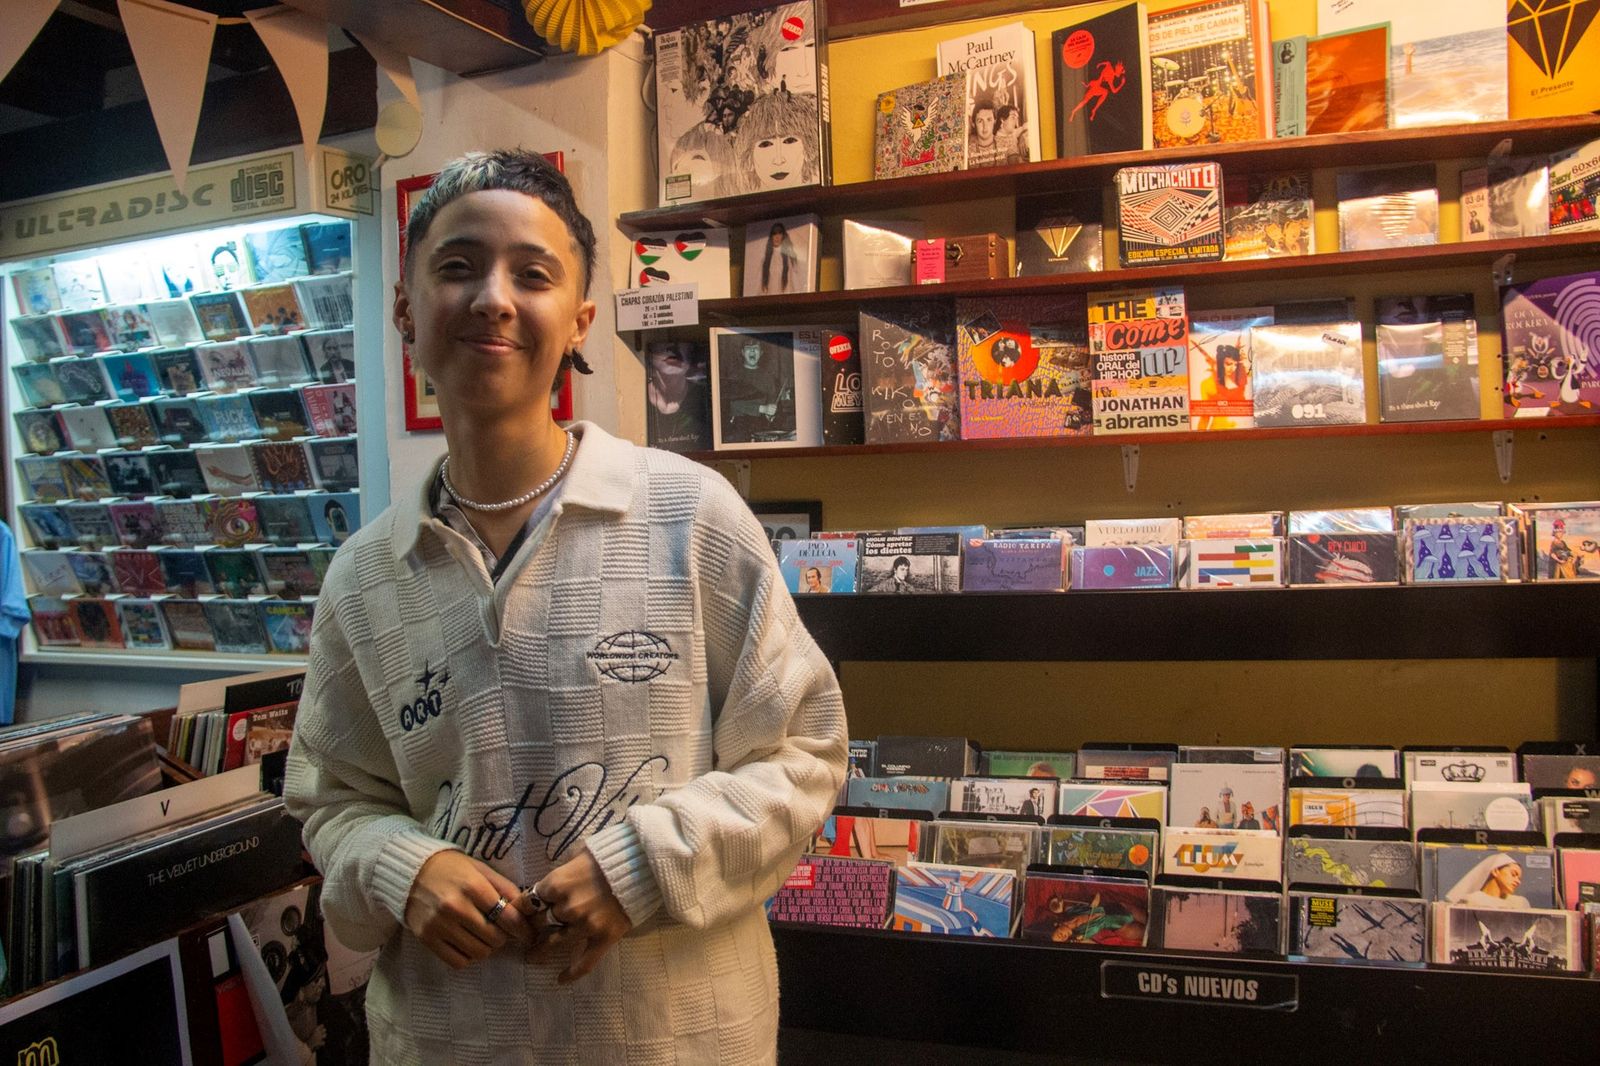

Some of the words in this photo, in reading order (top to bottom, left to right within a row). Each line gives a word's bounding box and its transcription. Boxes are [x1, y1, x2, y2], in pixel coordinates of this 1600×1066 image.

[967, 36, 994, 55] Paul
[948, 50, 1016, 74] McCartney
[820, 63, 831, 124] REVOLVER
[1540, 80, 1575, 94] Presente
[245, 161, 283, 175] COMPACT
[331, 163, 366, 190] ORO
[1121, 164, 1216, 195] MUCHACHITO
[230, 168, 284, 203] disc
[232, 201, 260, 212] DIGITAL
[261, 196, 285, 208] AUDIO
[330, 193, 340, 204] 24
[1155, 248, 1187, 257] ESPECIAL
[1188, 245, 1219, 255] LIMITADA
[621, 295, 641, 307] CHAPAS
[666, 291, 694, 302] PALESTINO
[1097, 298, 1148, 321] THE
[829, 343, 852, 355] OFERTA
[1099, 351, 1136, 361] historia
[1096, 361, 1125, 371] ORAL
[1125, 360, 1140, 370] del
[1100, 370, 1117, 380] HIP
[1117, 369, 1140, 380] HOP
[964, 378, 1063, 401] TRIANA
[1100, 396, 1184, 412] JONATHAN
[1291, 403, 1326, 419] 091
[1105, 413, 1179, 430] abrams
[880, 546, 913, 554] dientes
[1327, 541, 1342, 553] REY
[1343, 540, 1367, 553] CHICO
[1134, 566, 1159, 577] JAZZ
[638, 651, 680, 660] CREATORS
[252, 713, 267, 722] Tom
[269, 708, 289, 719] Waits
[400, 688, 442, 732] ART
[1574, 743, 1587, 755] X
[160, 800, 170, 817] V
[1100, 819, 1111, 828] G
[1344, 827, 1357, 840] N
[1475, 831, 1489, 843] R
[147, 871, 166, 887] THE
[166, 857, 198, 881] VELVET
[198, 836, 260, 868] UNDERGROUND
[1183, 850, 1238, 866] LLUM
[1311, 899, 1334, 907] MUSE
[1137, 971, 1178, 995] CD's
[1184, 975, 1259, 1001] NUEVOS
